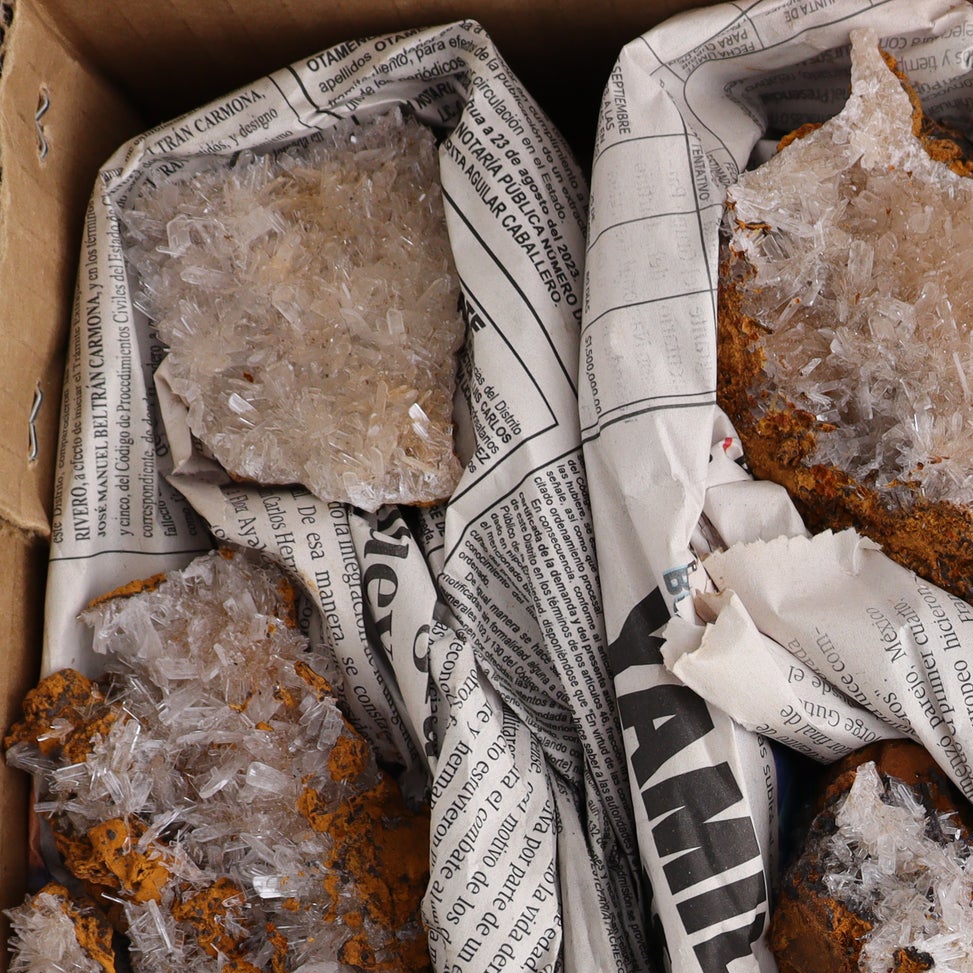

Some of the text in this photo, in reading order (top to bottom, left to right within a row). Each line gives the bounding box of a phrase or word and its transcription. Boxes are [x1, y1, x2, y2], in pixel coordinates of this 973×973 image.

[318, 51, 372, 94] apellidos
[415, 40, 446, 62] para
[194, 89, 267, 133] CARMONA,
[239, 107, 279, 137] designó
[611, 66, 631, 135] SEPTIEMBRE
[472, 75, 565, 225] circulación en Estado.
[454, 121, 577, 307] NOTARÍA PÚBLICA NÚMERO
[465, 163, 561, 308] AGUILAR CABALLERO.
[490, 129, 580, 282] 23 de agosto del 2023.
[86, 292, 109, 499] MANUEL BELTRÁN CARMONA,
[112, 285, 134, 527] cinco, Código Procedimientos Civiles
[480, 401, 512, 444] CARLOS
[494, 400, 522, 436] Distrito
[72, 480, 90, 541] RIVERO,
[533, 476, 585, 574] citado ordenamiento
[298, 505, 345, 646] De esa manera,
[538, 515, 596, 631] consecuencia, conforme
[490, 604, 521, 634] manera
[866, 606, 906, 664] México
[917, 584, 962, 651] hicieron
[905, 665, 945, 730] parejo,
[433, 760, 490, 848] estuvieron
[441, 808, 488, 880] combate
[446, 814, 518, 925] motivo de los
[457, 835, 542, 963] por parte de un
[508, 904, 540, 942] vida
[532, 884, 554, 903] la
[520, 927, 557, 970] edad,
